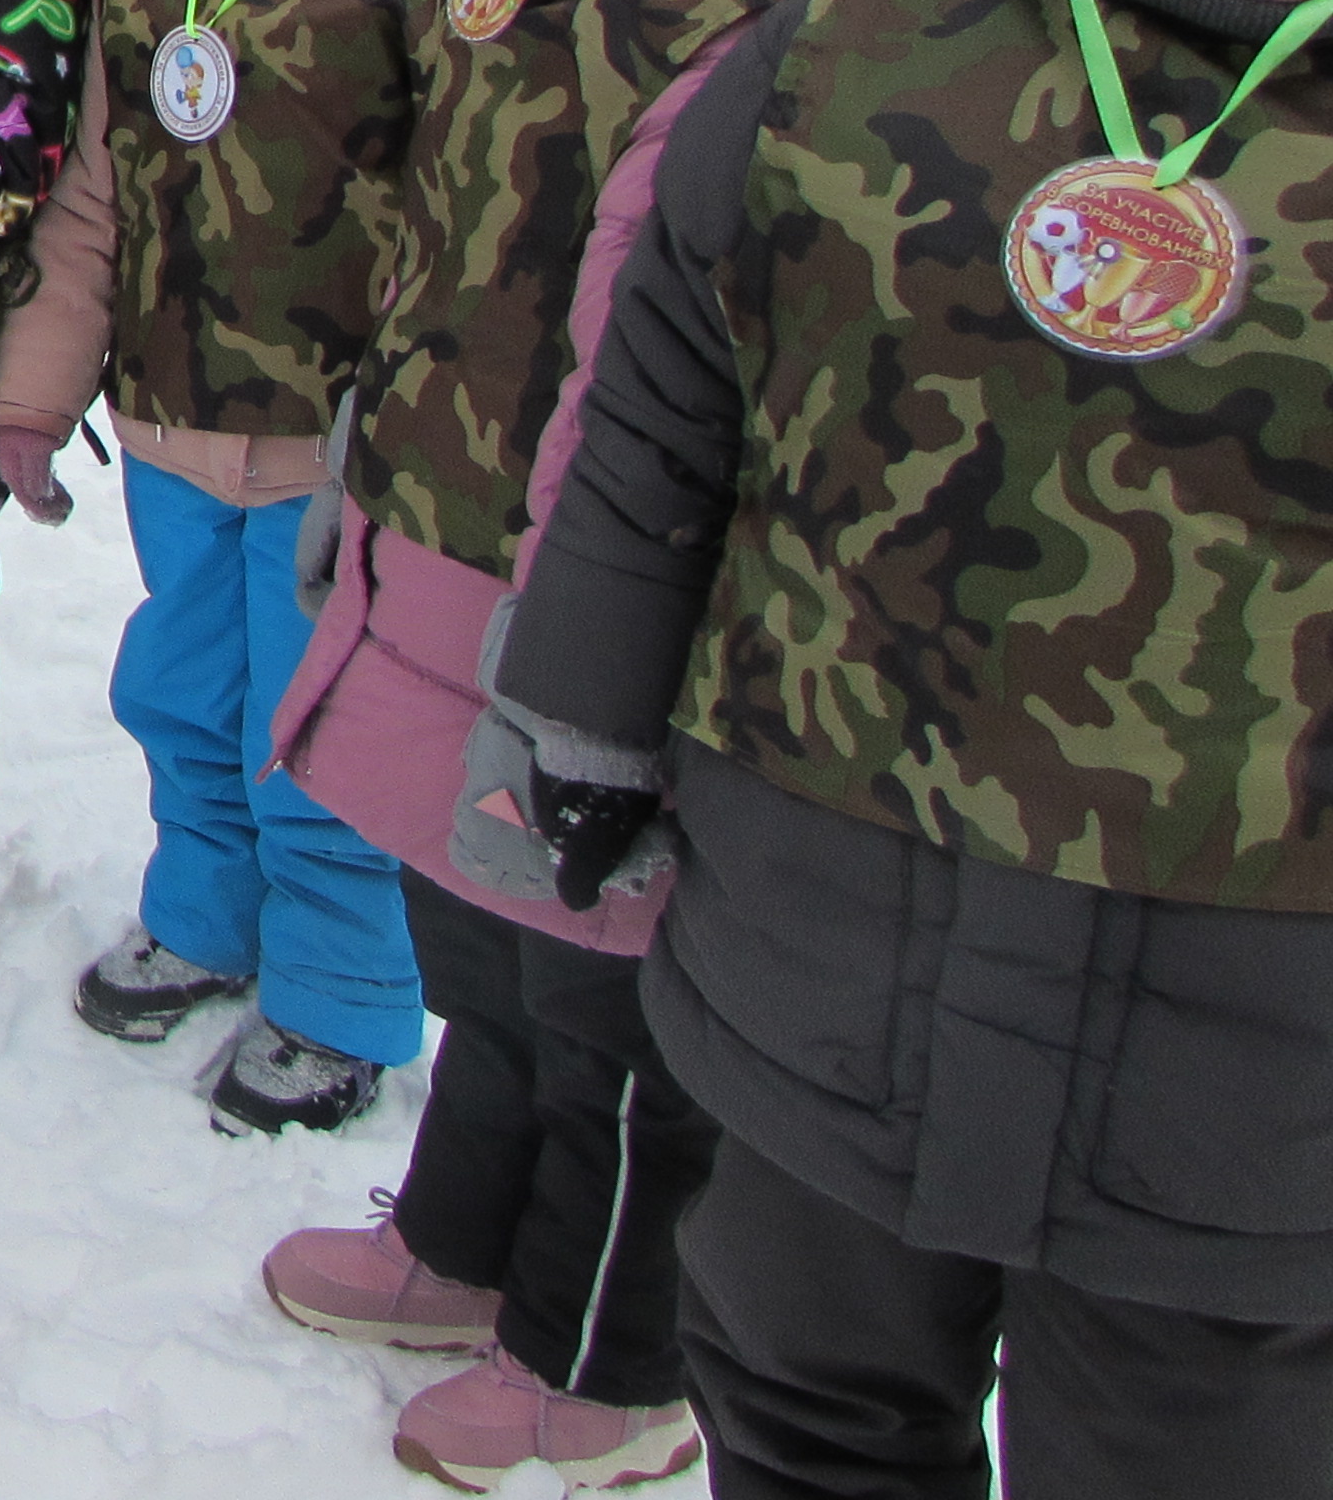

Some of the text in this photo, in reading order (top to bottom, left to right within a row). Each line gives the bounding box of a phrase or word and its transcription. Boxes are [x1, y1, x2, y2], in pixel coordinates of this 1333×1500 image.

[1060, 194, 1228, 269] СОРЕВНОВАНИЯХ
[1084, 183, 1205, 243] ЗА УЧАСТИЕ
